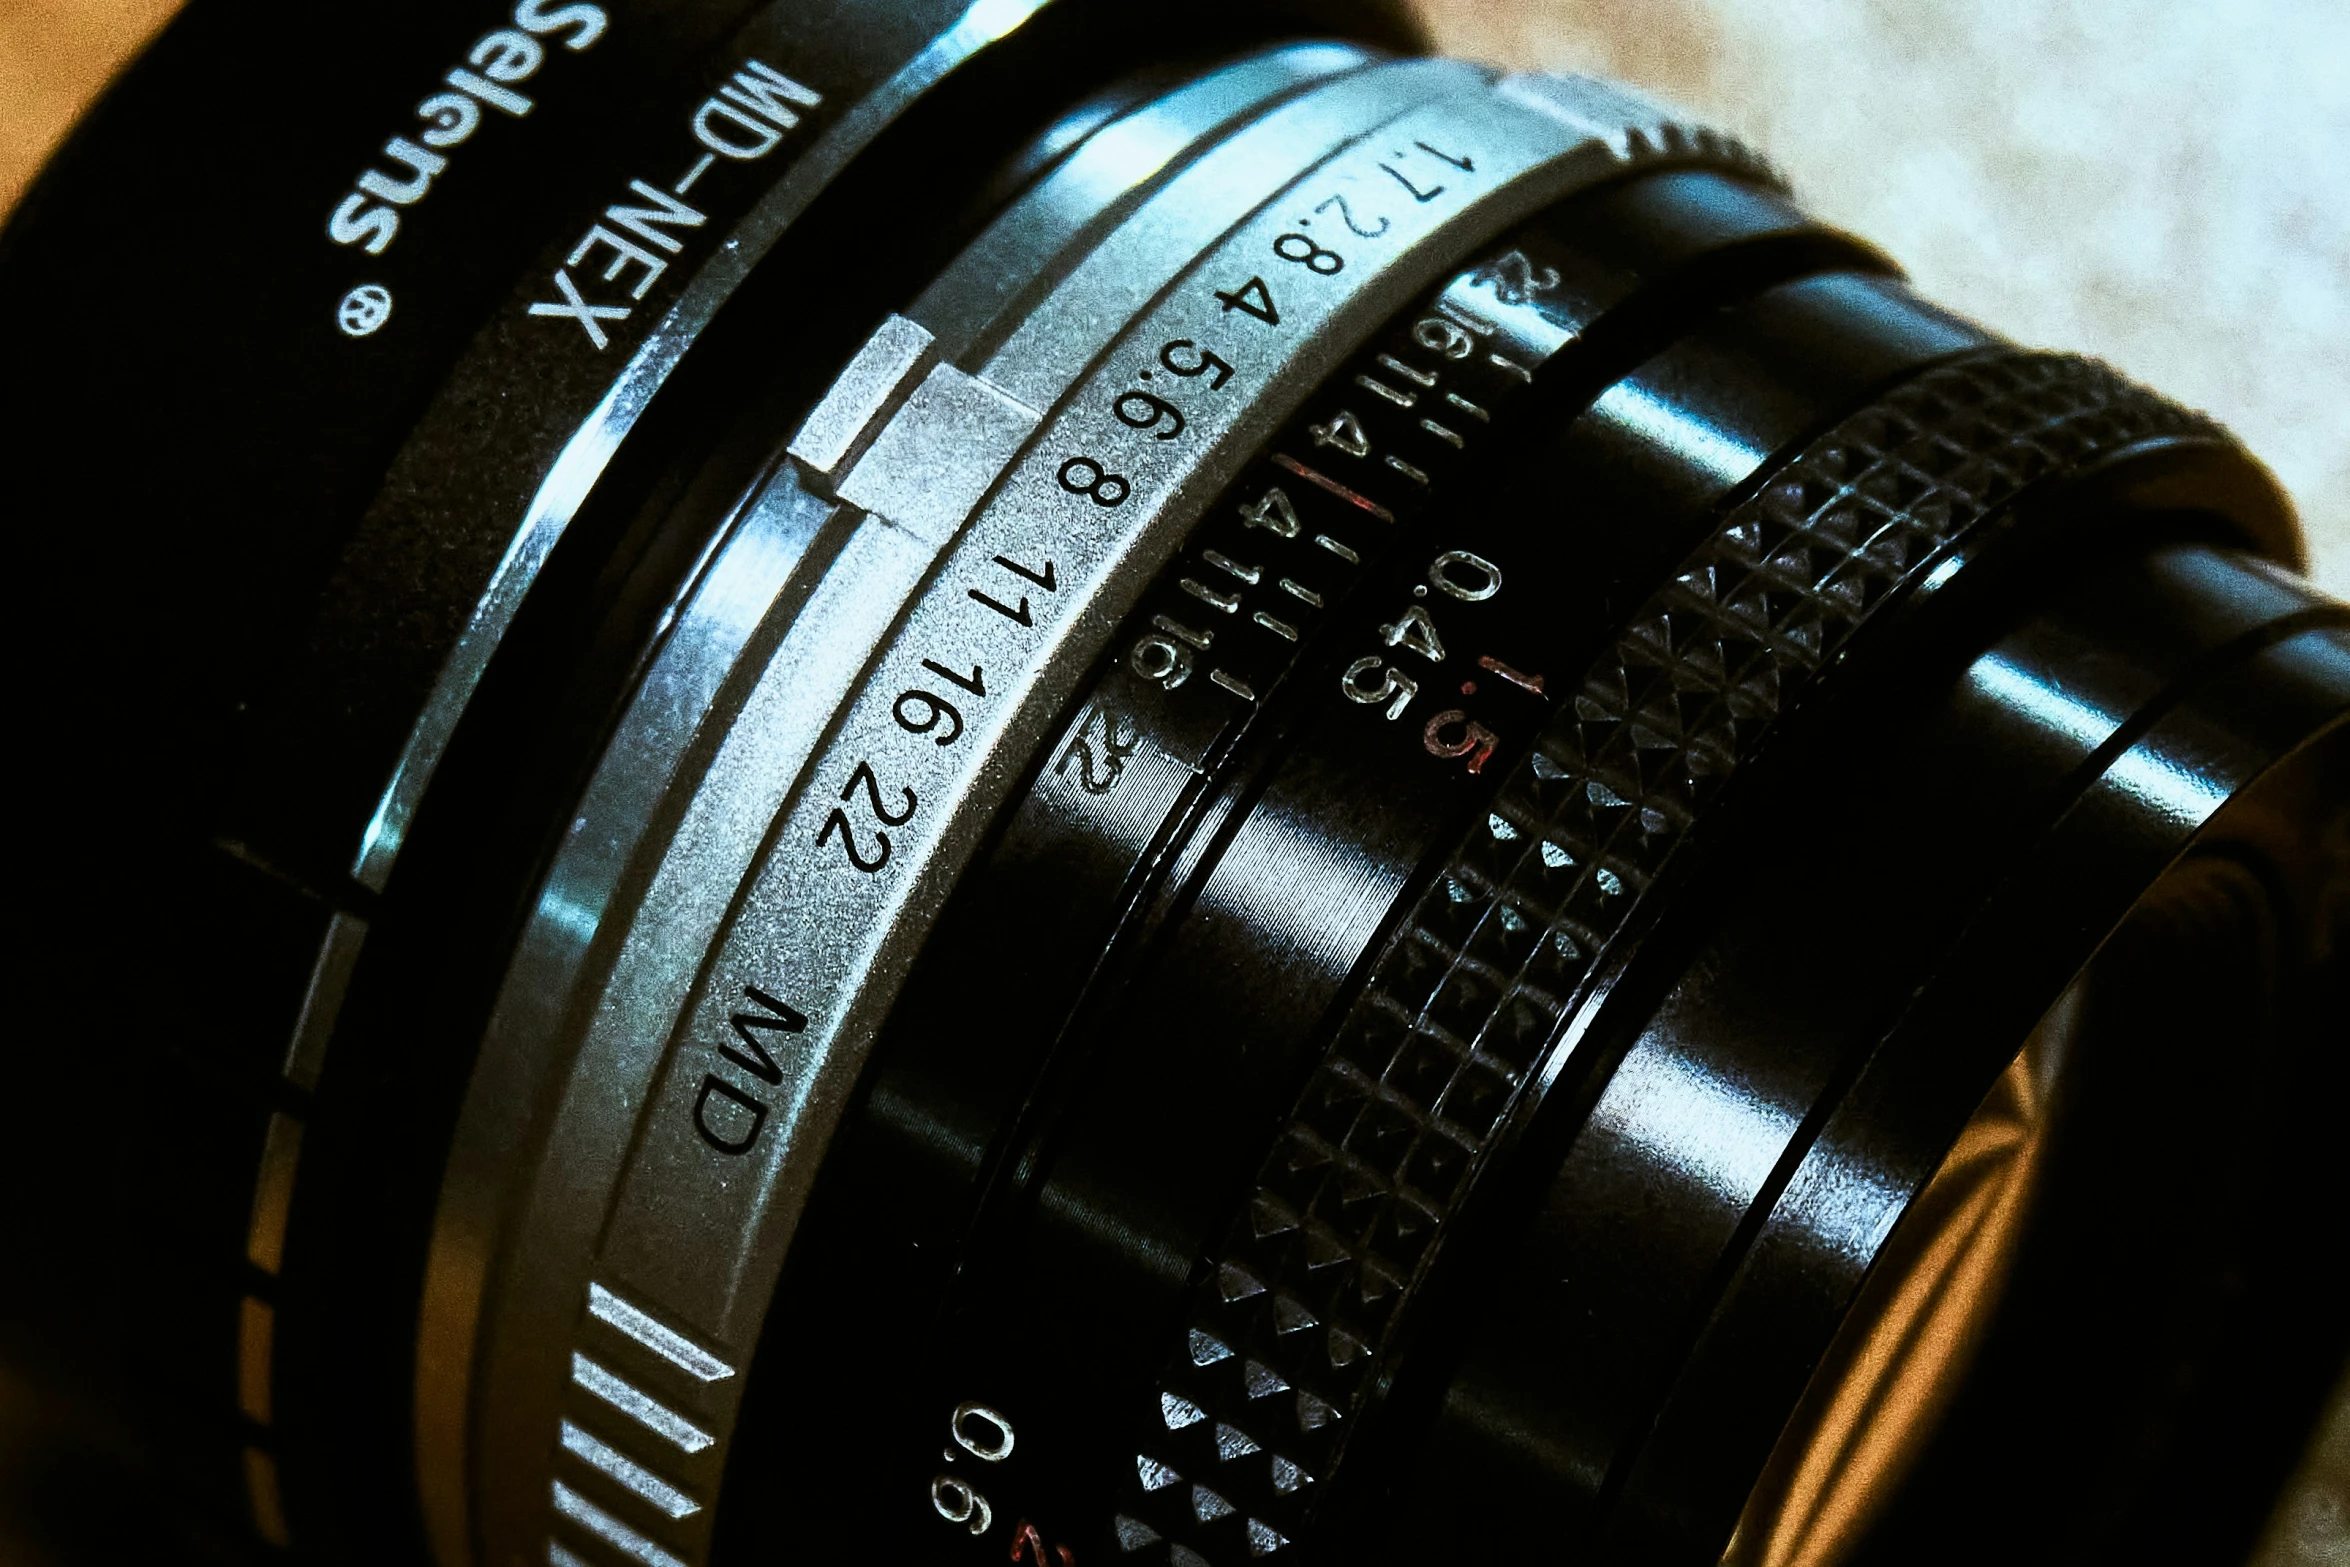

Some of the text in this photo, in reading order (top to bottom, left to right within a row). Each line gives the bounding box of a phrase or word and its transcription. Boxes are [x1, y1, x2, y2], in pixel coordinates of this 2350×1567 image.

[328, 0, 608, 255] Selens
[528, 57, 823, 350] MD-NEX
[1355, 352, 1440, 408] 11
[1412, 298, 1498, 359] 16
[1309, 411, 1370, 458] 4
[816, 140, 1475, 873] 1.7 2.8 4 5.6 8 11 16 22
[1238, 487, 1301, 538] 4
[1180, 549, 1264, 614] 11
[1130, 614, 1214, 690] 16
[1342, 550, 1502, 720] 0.45
[1054, 709, 1145, 796] 22
[1424, 655, 1548, 774] 1.5
[693, 985, 808, 1156] MD
[931, 1400, 1015, 1536] 0.6
